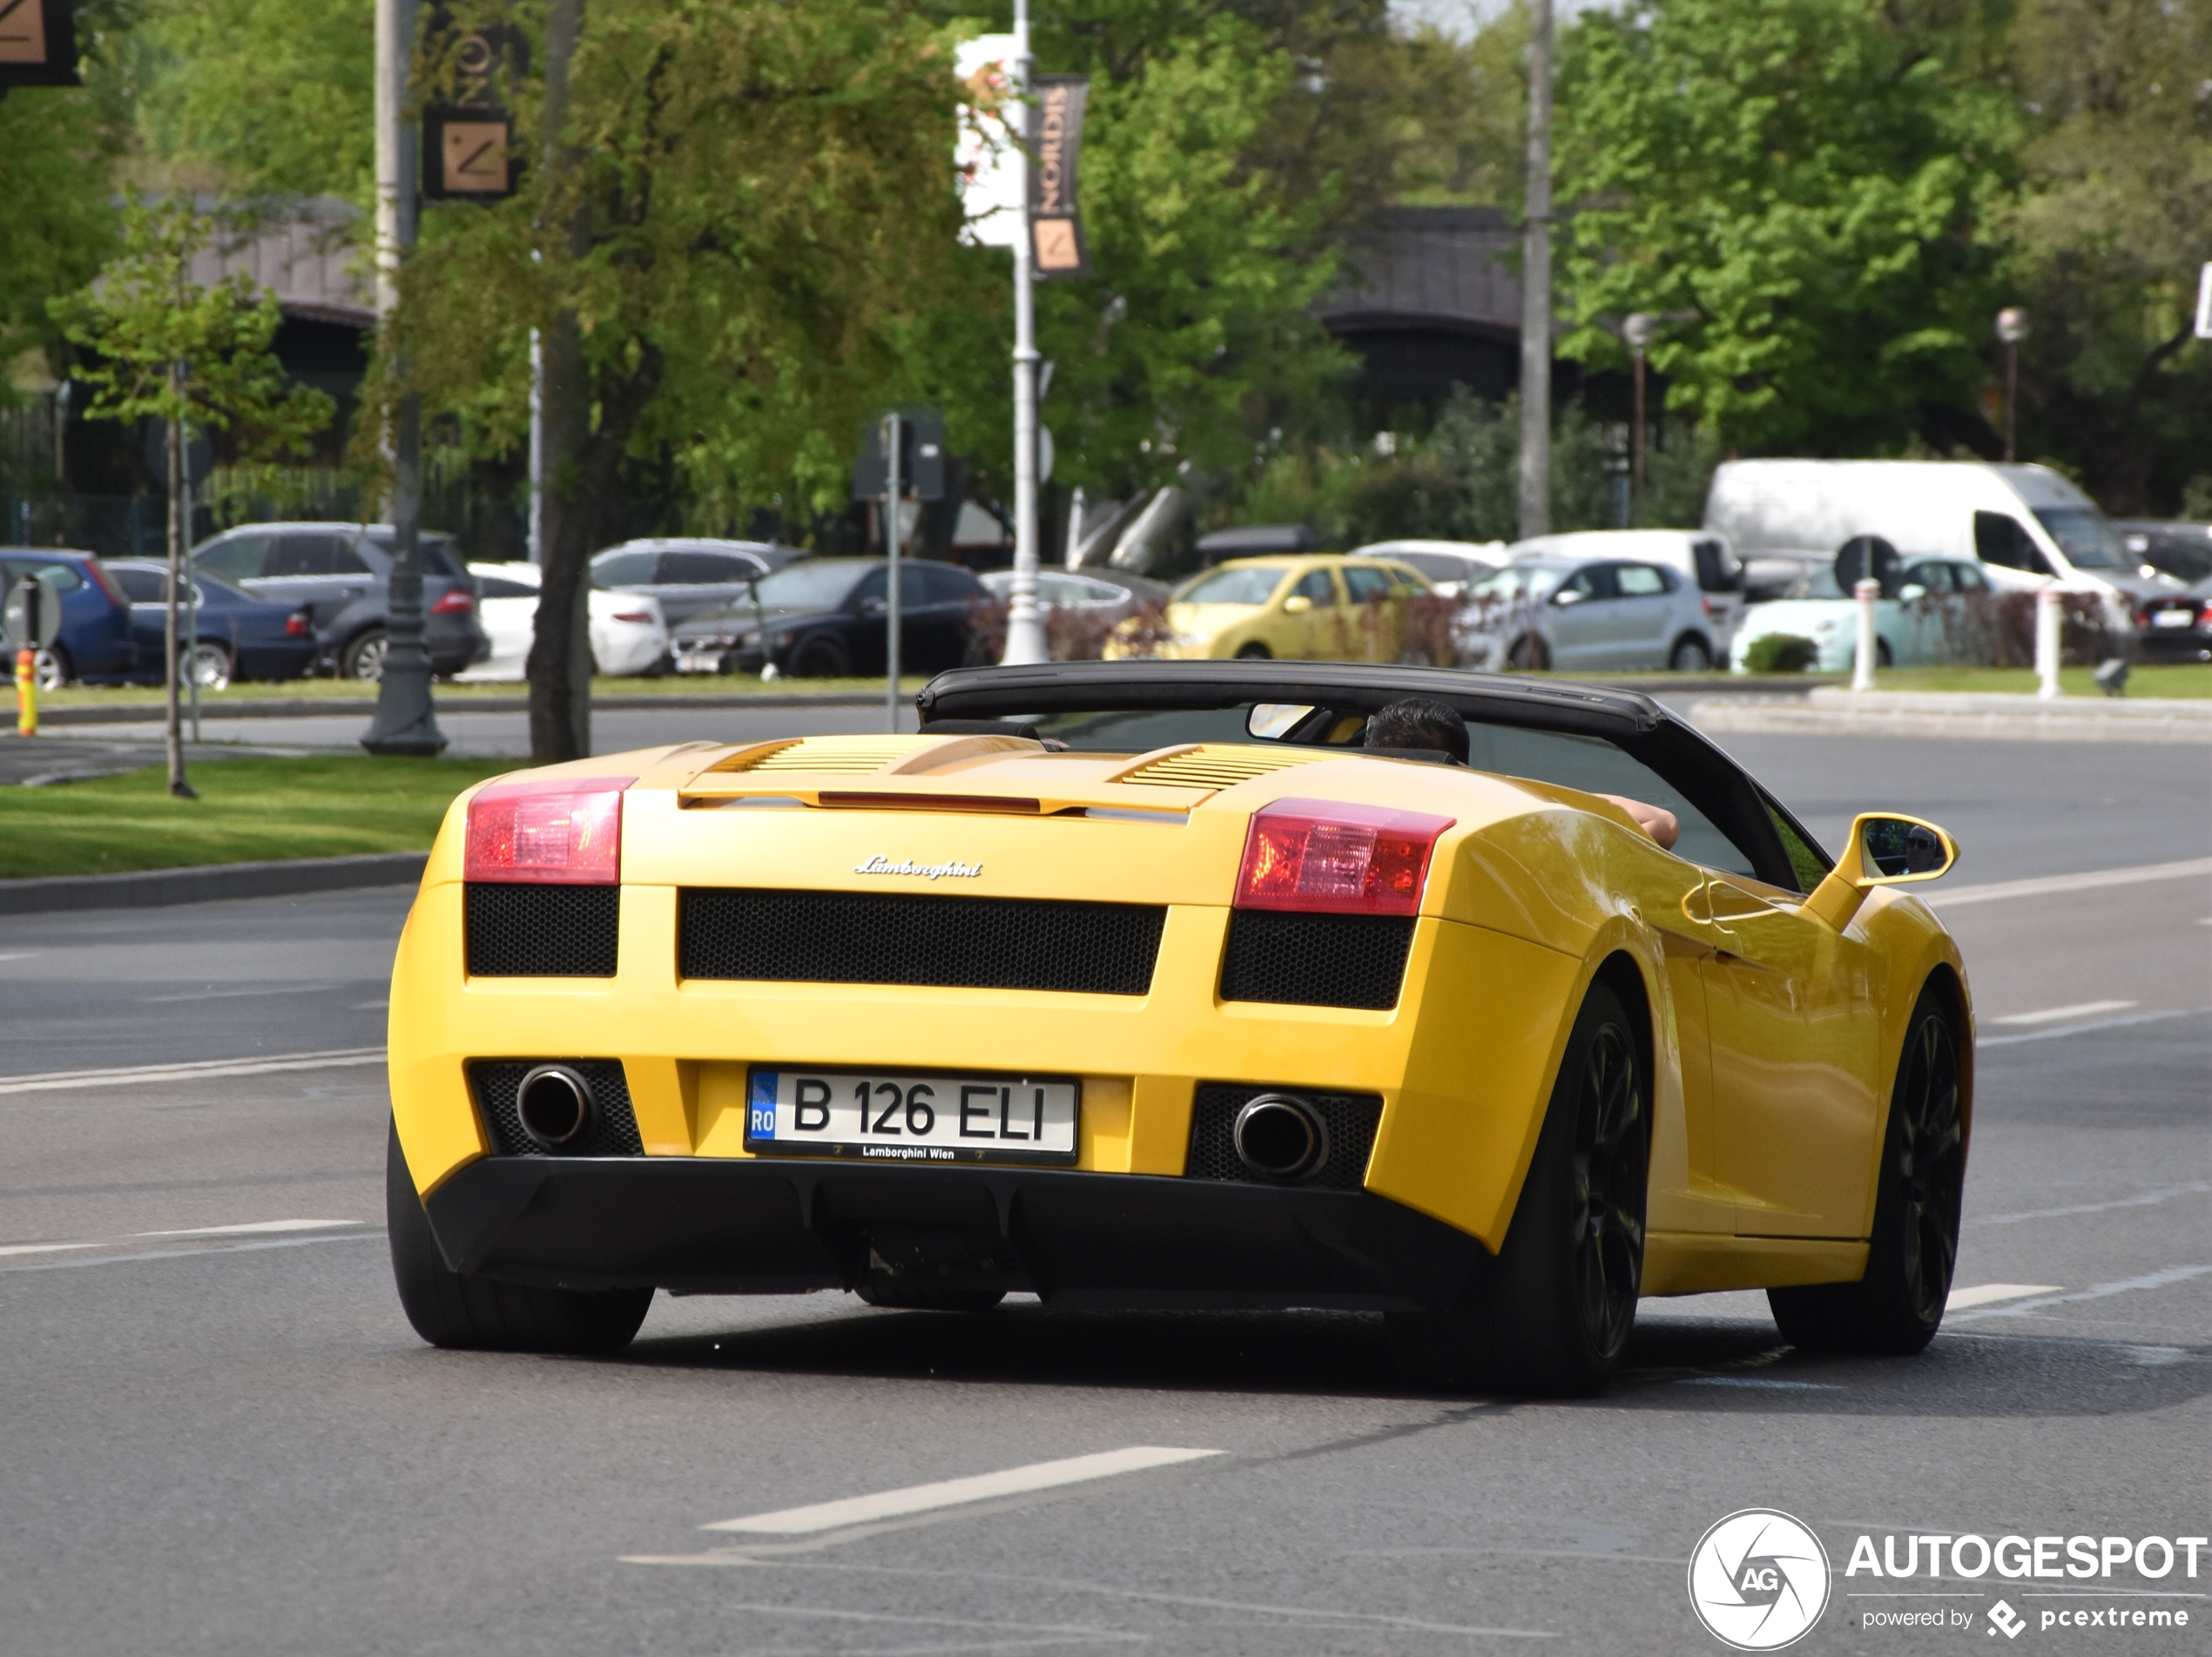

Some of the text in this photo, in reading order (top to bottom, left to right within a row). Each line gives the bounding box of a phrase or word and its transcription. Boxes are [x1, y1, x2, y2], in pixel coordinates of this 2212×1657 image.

[1039, 86, 1069, 213] NORDIS
[853, 855, 983, 880] Lamborghini
[752, 1109, 774, 1132] RO
[794, 1078, 1044, 1142] B 126 ELI
[863, 1145, 954, 1160] Lamborghini Wien
